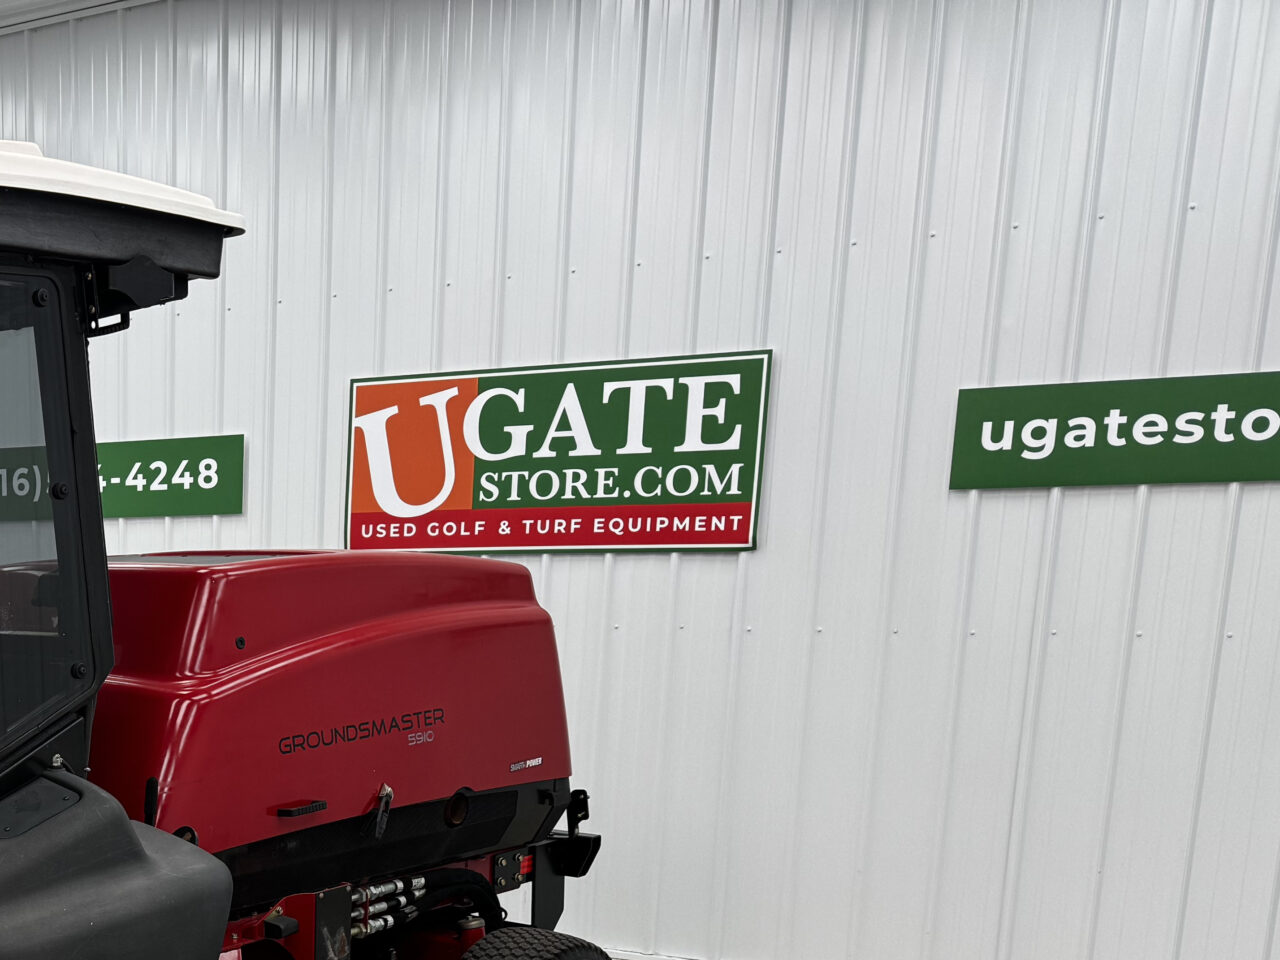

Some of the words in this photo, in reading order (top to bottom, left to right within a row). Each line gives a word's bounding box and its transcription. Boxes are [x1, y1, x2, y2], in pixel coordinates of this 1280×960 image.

[354, 373, 742, 518] UGATE
[478, 463, 744, 502] STORE.COM
[361, 523, 417, 538] USED
[427, 520, 486, 537] GOLF
[498, 520, 511, 535] &
[522, 518, 583, 535] TURF
[593, 515, 743, 536] EQUIPMENT
[278, 708, 445, 754] GROUNDSMASTER
[407, 730, 435, 747] 5910
